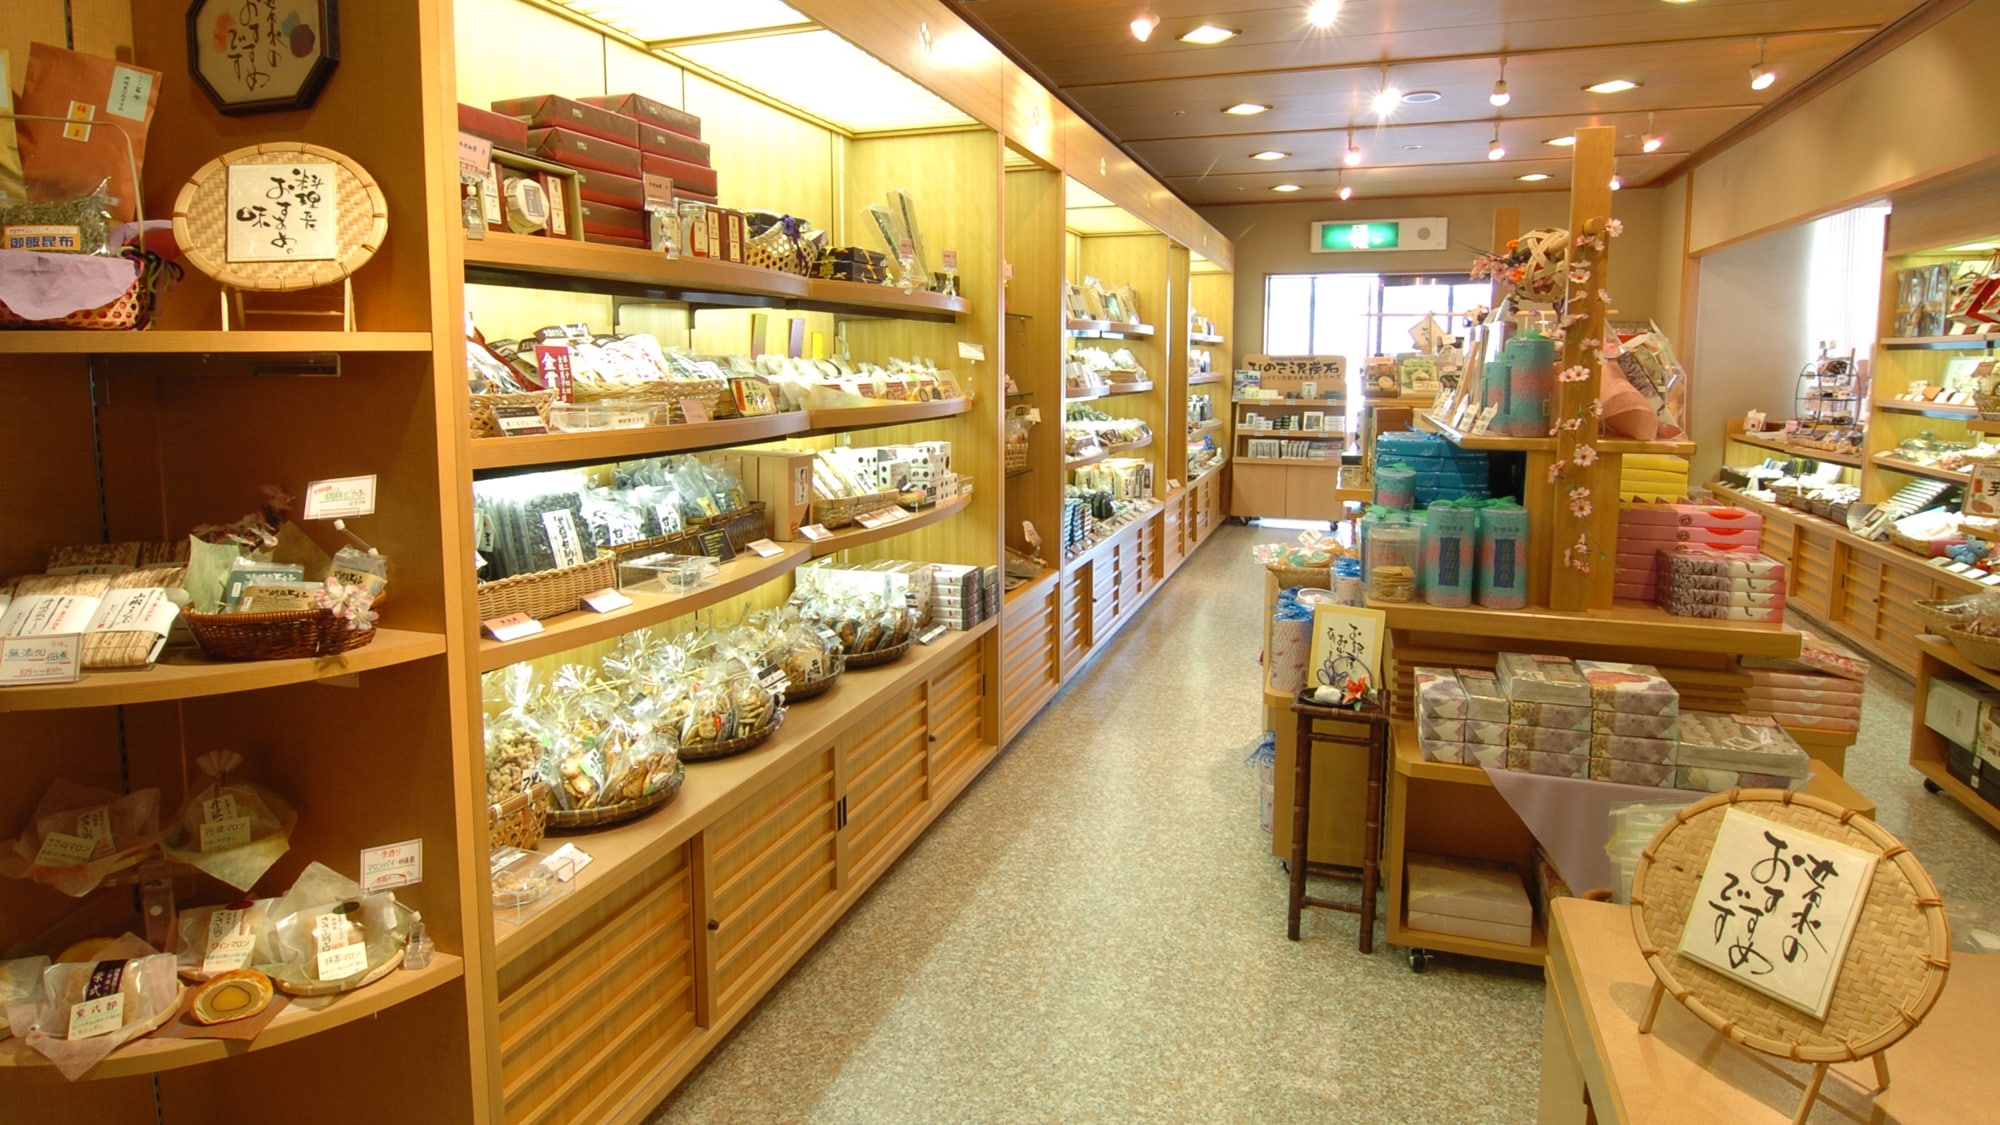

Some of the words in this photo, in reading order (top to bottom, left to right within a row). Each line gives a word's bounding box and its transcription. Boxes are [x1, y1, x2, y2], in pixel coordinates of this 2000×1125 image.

[227, 28, 246, 81] です
[236, 205, 271, 228] 味
[292, 168, 324, 232] 料理長
[10, 235, 74, 248] 御飯昆布
[1708, 872, 1751, 946] です
[1728, 830, 1806, 975] おすすめ
